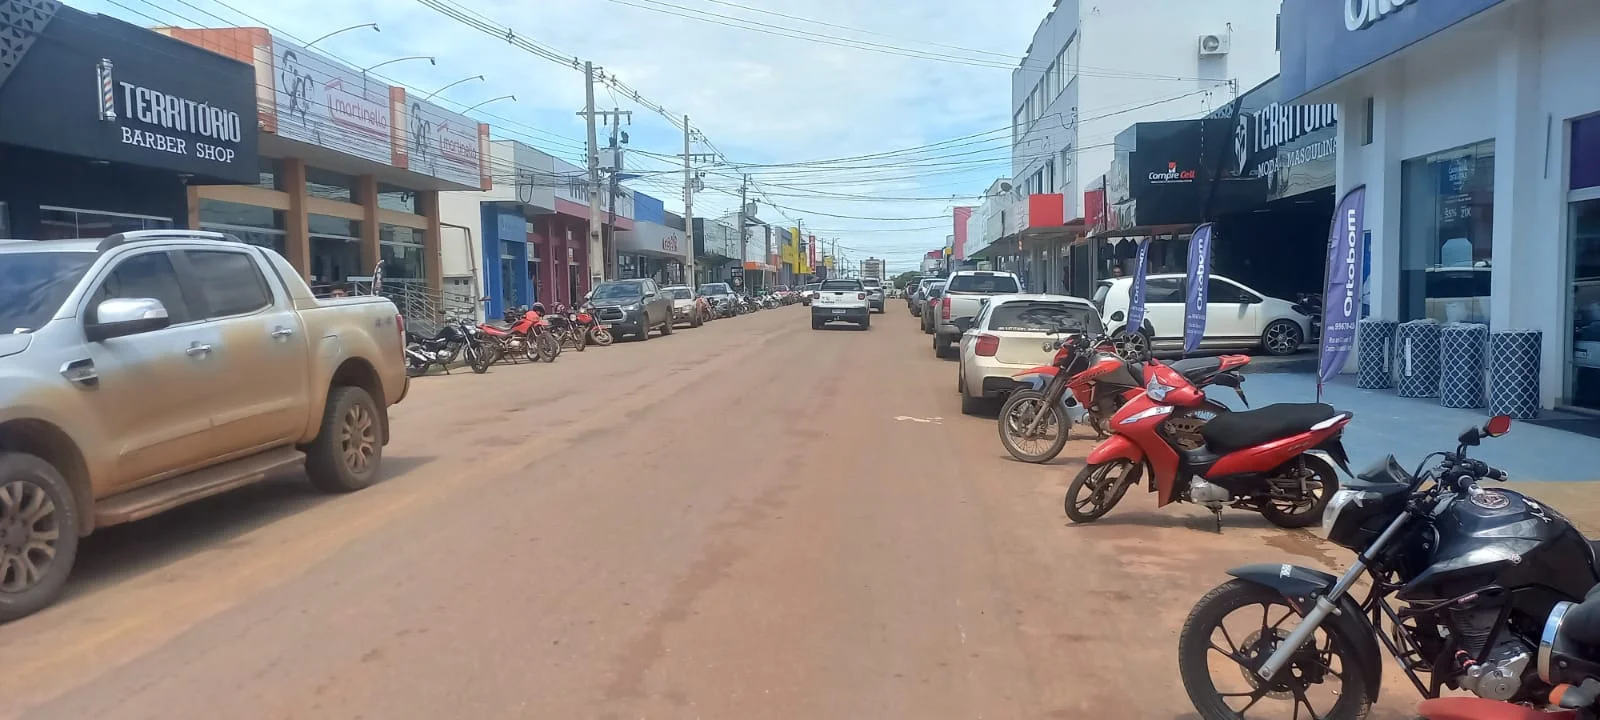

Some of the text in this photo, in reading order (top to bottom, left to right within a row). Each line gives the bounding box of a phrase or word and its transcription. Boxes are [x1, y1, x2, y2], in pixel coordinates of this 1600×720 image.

[120, 81, 241, 143] TERRITÓRIO
[335, 98, 387, 129] martinello
[121, 126, 235, 163] BARBER SHOP
[1180, 170, 1196, 179] Cell
[1257, 158, 1280, 178] MODA
[1343, 208, 1357, 317] Ortobom
